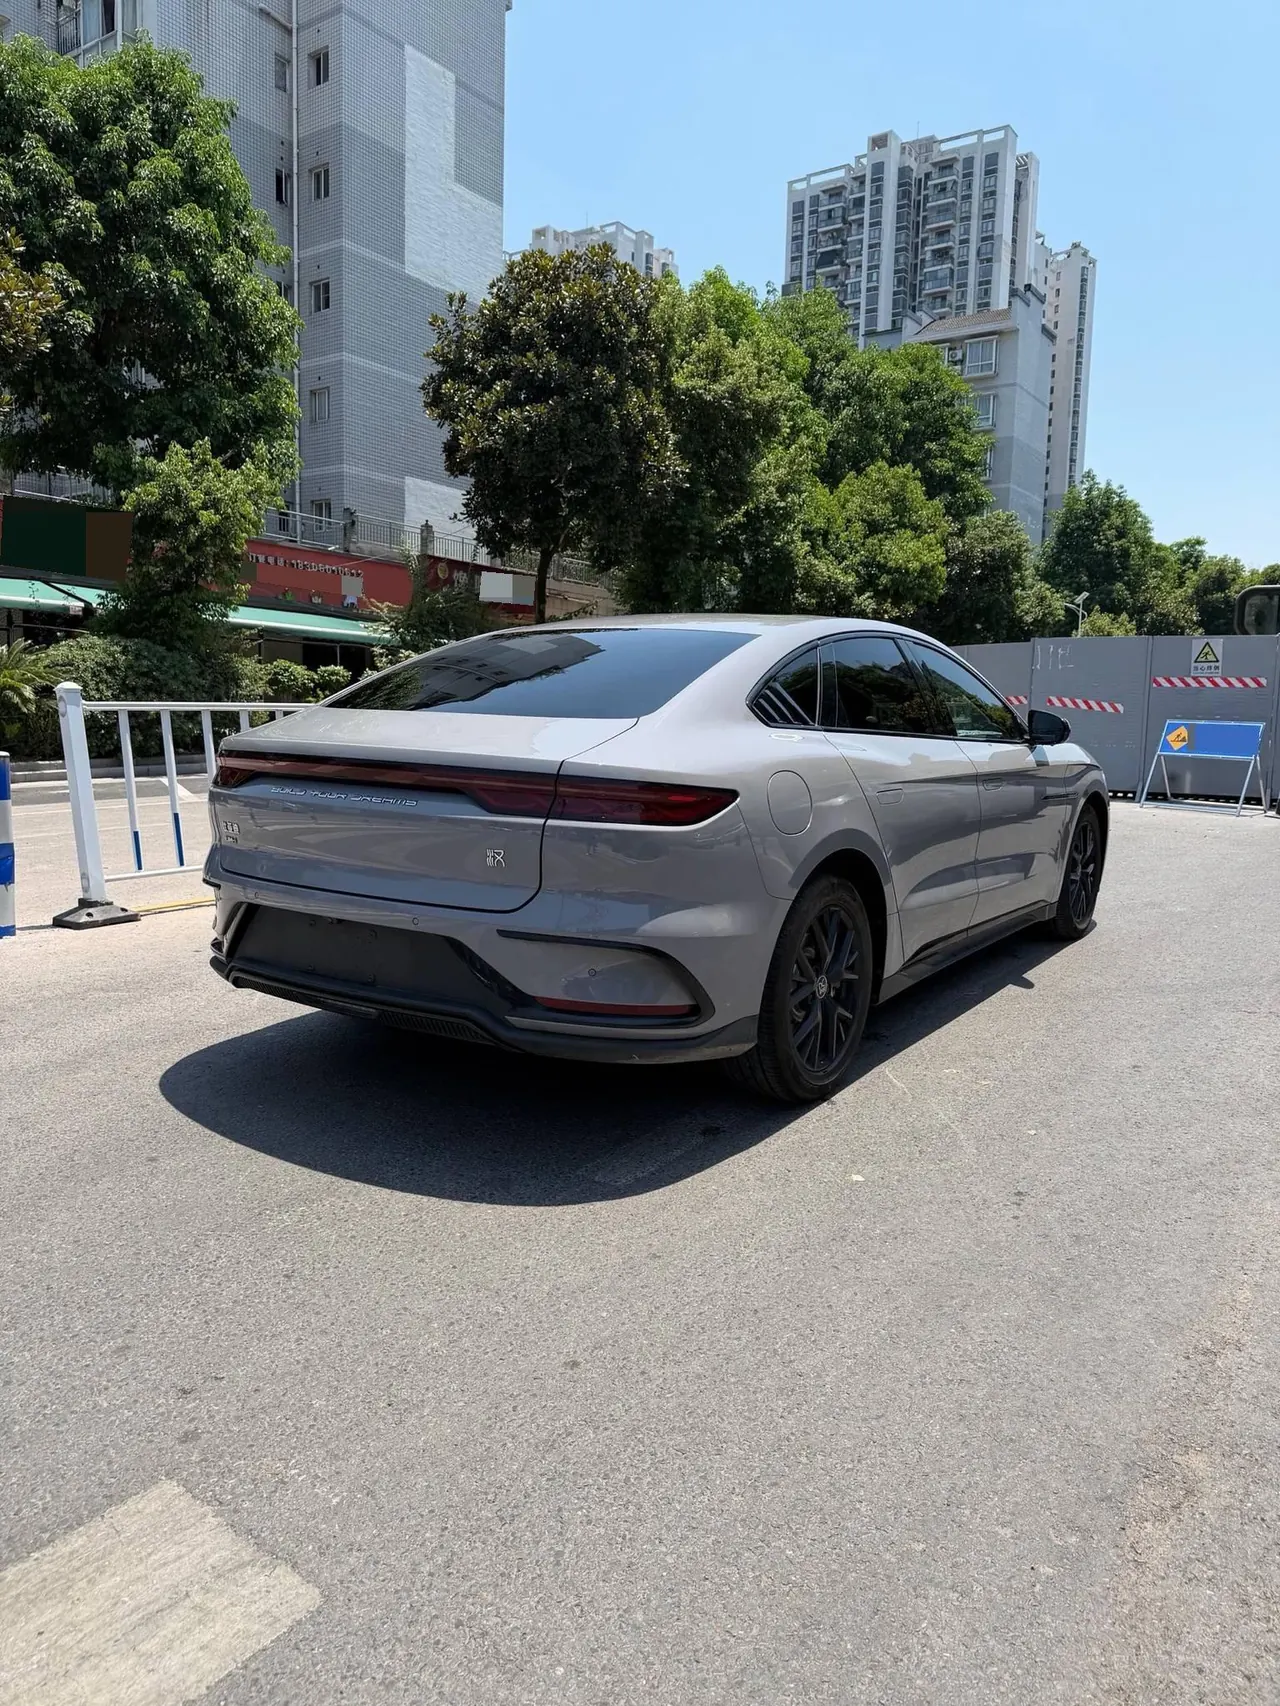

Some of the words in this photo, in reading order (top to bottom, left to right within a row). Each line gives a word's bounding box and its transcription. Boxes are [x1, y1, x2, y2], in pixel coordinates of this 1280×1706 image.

[270, 786, 306, 795] BUILD
[310, 790, 347, 799] YOUR
[350, 795, 418, 806] DREAMS
